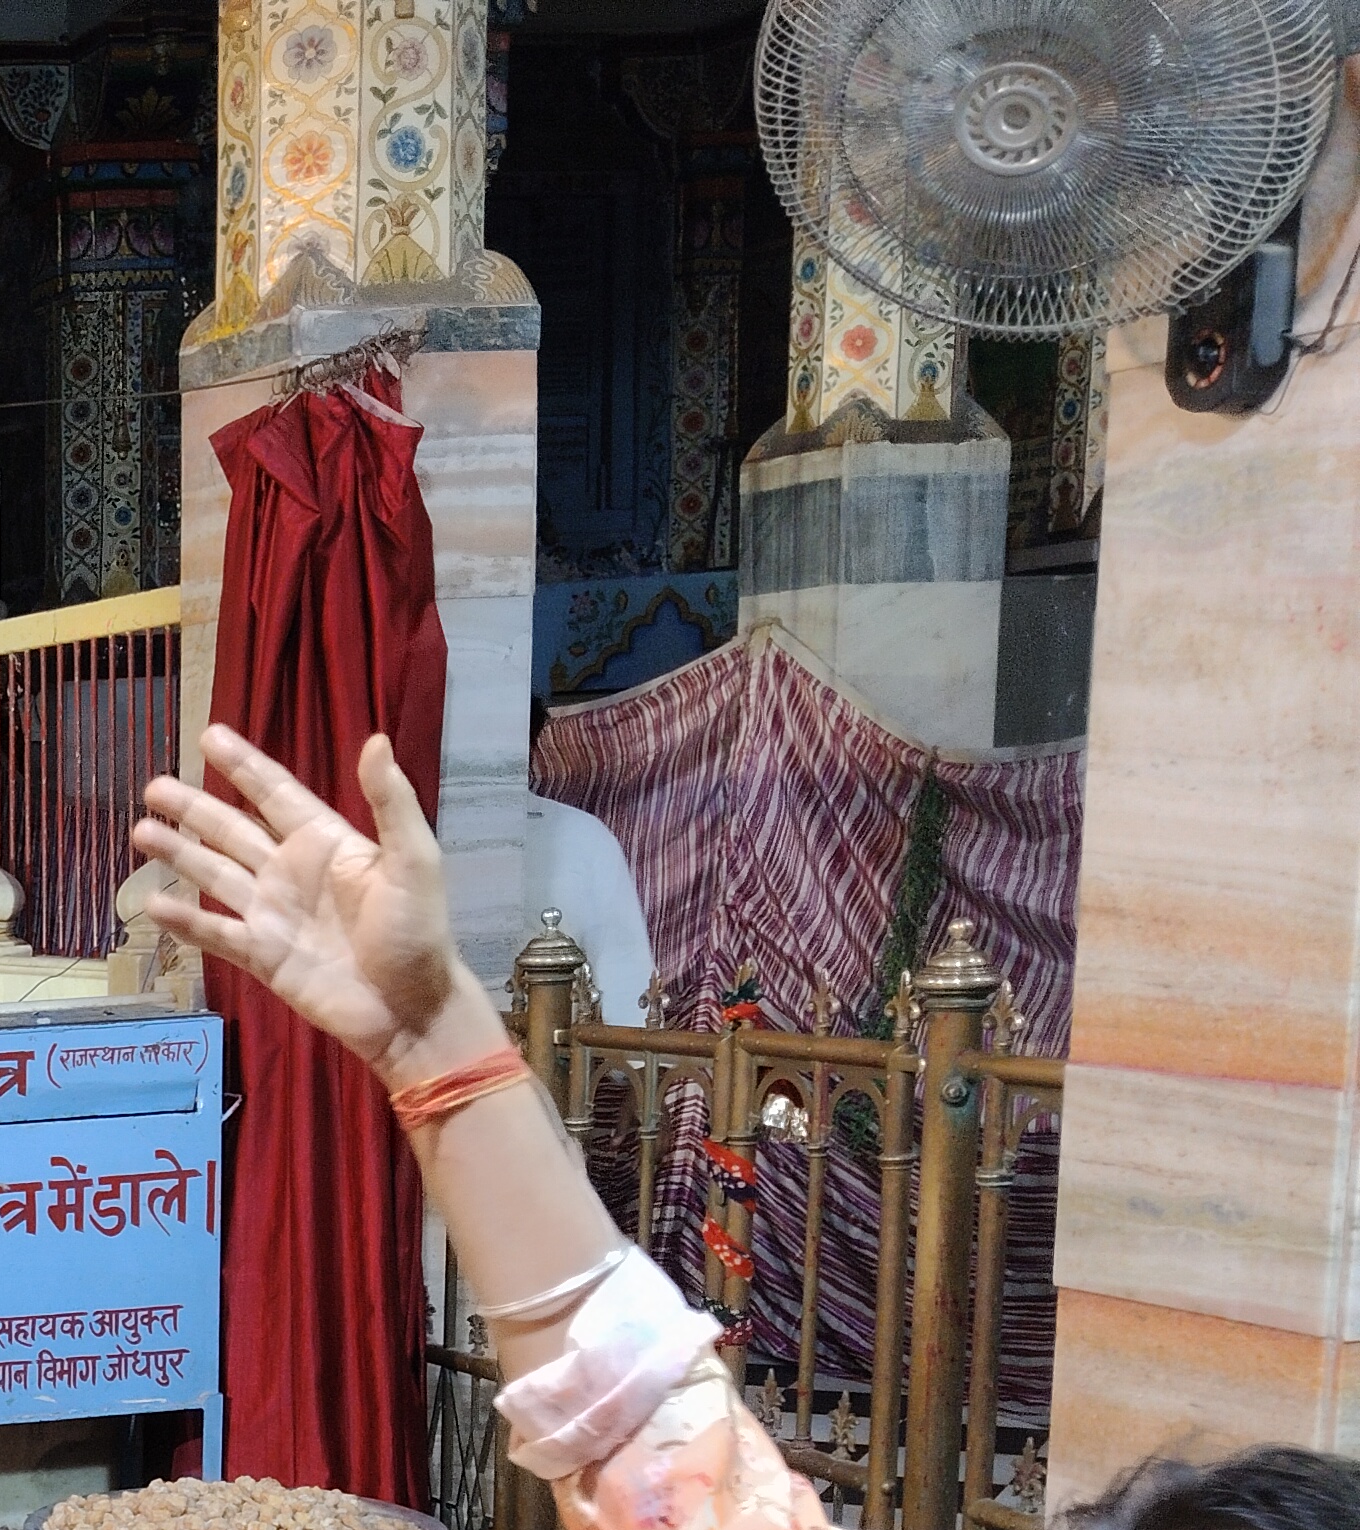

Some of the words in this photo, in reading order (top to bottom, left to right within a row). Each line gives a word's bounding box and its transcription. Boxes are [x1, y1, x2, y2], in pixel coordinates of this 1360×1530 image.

[88, 1305, 184, 1345] आयुक्त
[36, 1349, 102, 1390] विभाग
[102, 1345, 189, 1387] जोधपुर
